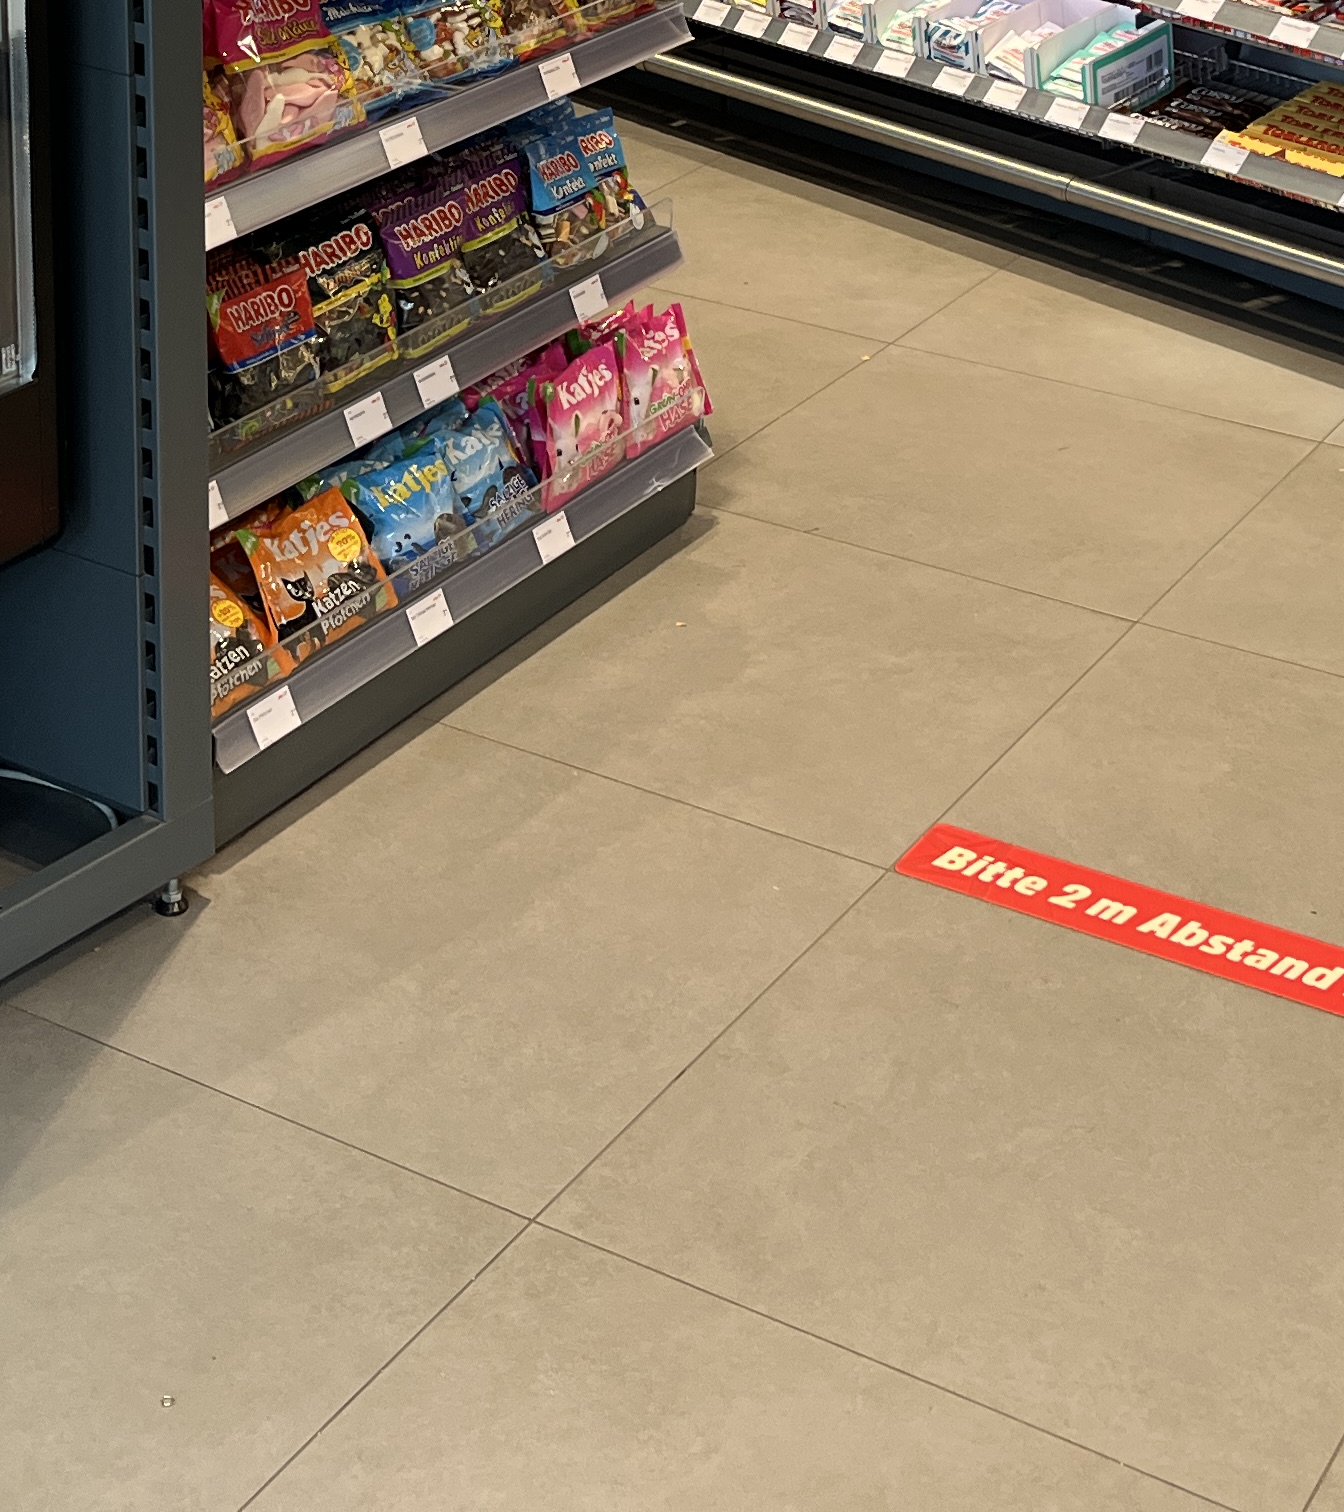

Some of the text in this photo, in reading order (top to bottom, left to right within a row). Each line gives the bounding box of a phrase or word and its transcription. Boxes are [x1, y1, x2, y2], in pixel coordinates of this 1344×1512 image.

[463, 168, 519, 214] HARIBO
[537, 150, 580, 183] HARIBO
[396, 200, 464, 250] HARIBO
[297, 223, 373, 278] HARIBO
[226, 284, 297, 333] HARIBO
[557, 362, 613, 411] Katjes
[263, 510, 351, 563] Katjes
[311, 577, 360, 619] Katzen
[320, 590, 372, 636] Pfötchen
[209, 643, 250, 680] atzen
[931, 844, 1048, 896] Bitte
[1048, 883, 1093, 909] 2
[1085, 896, 1138, 925] m
